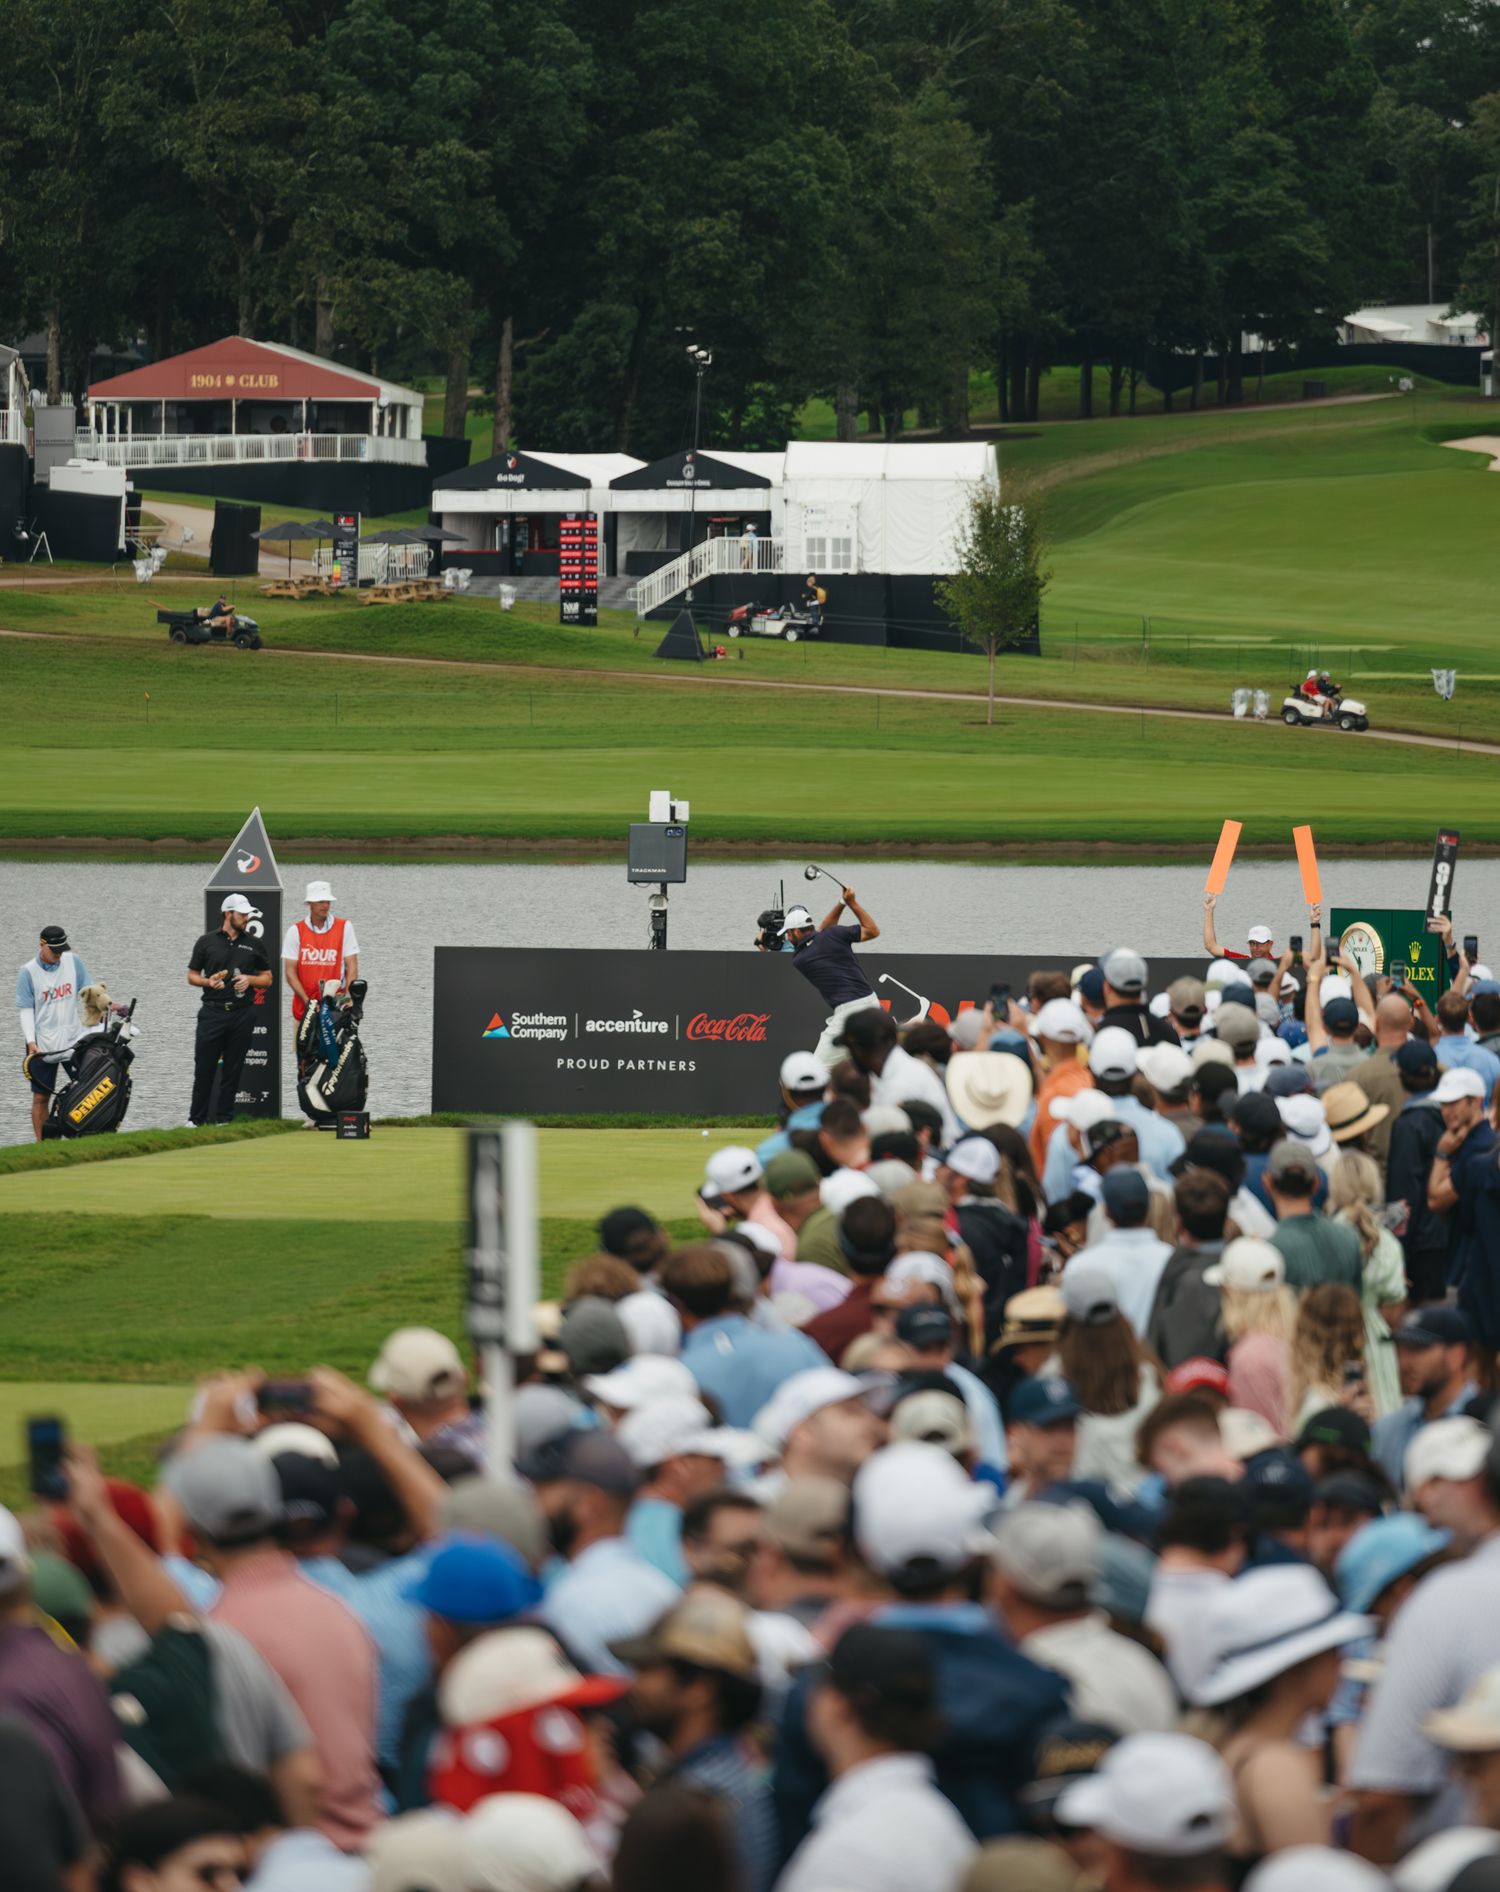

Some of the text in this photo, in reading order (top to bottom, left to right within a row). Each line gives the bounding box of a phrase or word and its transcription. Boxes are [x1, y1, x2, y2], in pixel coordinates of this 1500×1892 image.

[191, 374, 278, 387] 1904 CLUB
[300, 947, 337, 962] TOUR
[42, 983, 72, 1002] TOUR
[511, 1012, 567, 1026] Southern
[585, 1016, 669, 1033] accenture
[686, 1012, 771, 1041] Coca-Cola
[510, 1025, 568, 1041] Company
[557, 1058, 697, 1072] PROUD PARTNERS
